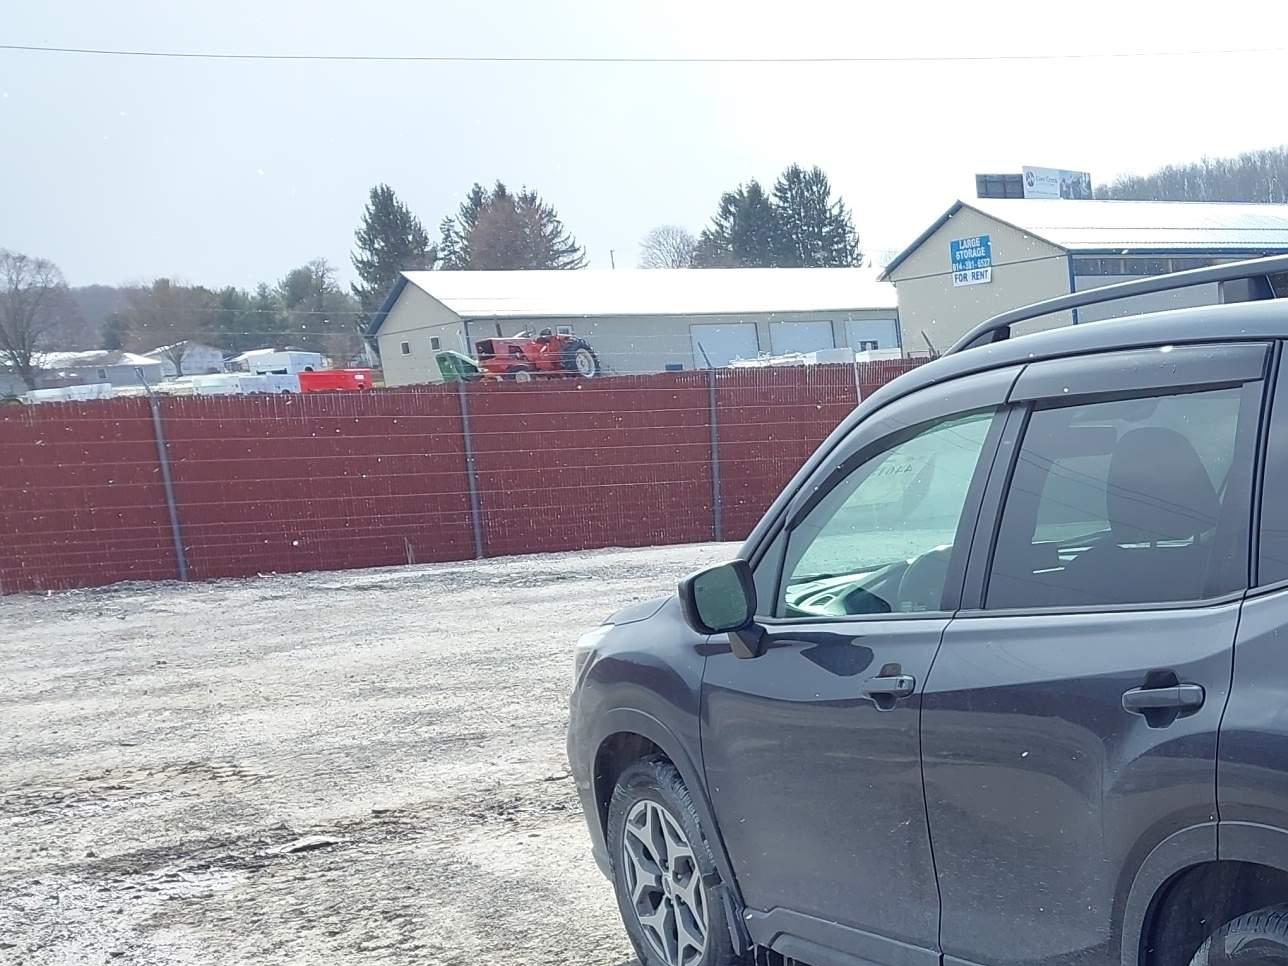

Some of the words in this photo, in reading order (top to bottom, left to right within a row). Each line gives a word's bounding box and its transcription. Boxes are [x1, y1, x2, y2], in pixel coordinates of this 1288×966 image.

[959, 237, 981, 250] LARGE
[955, 247, 986, 260] STORAGE
[954, 272, 969, 283] FOR
[971, 269, 989, 281] RENT
